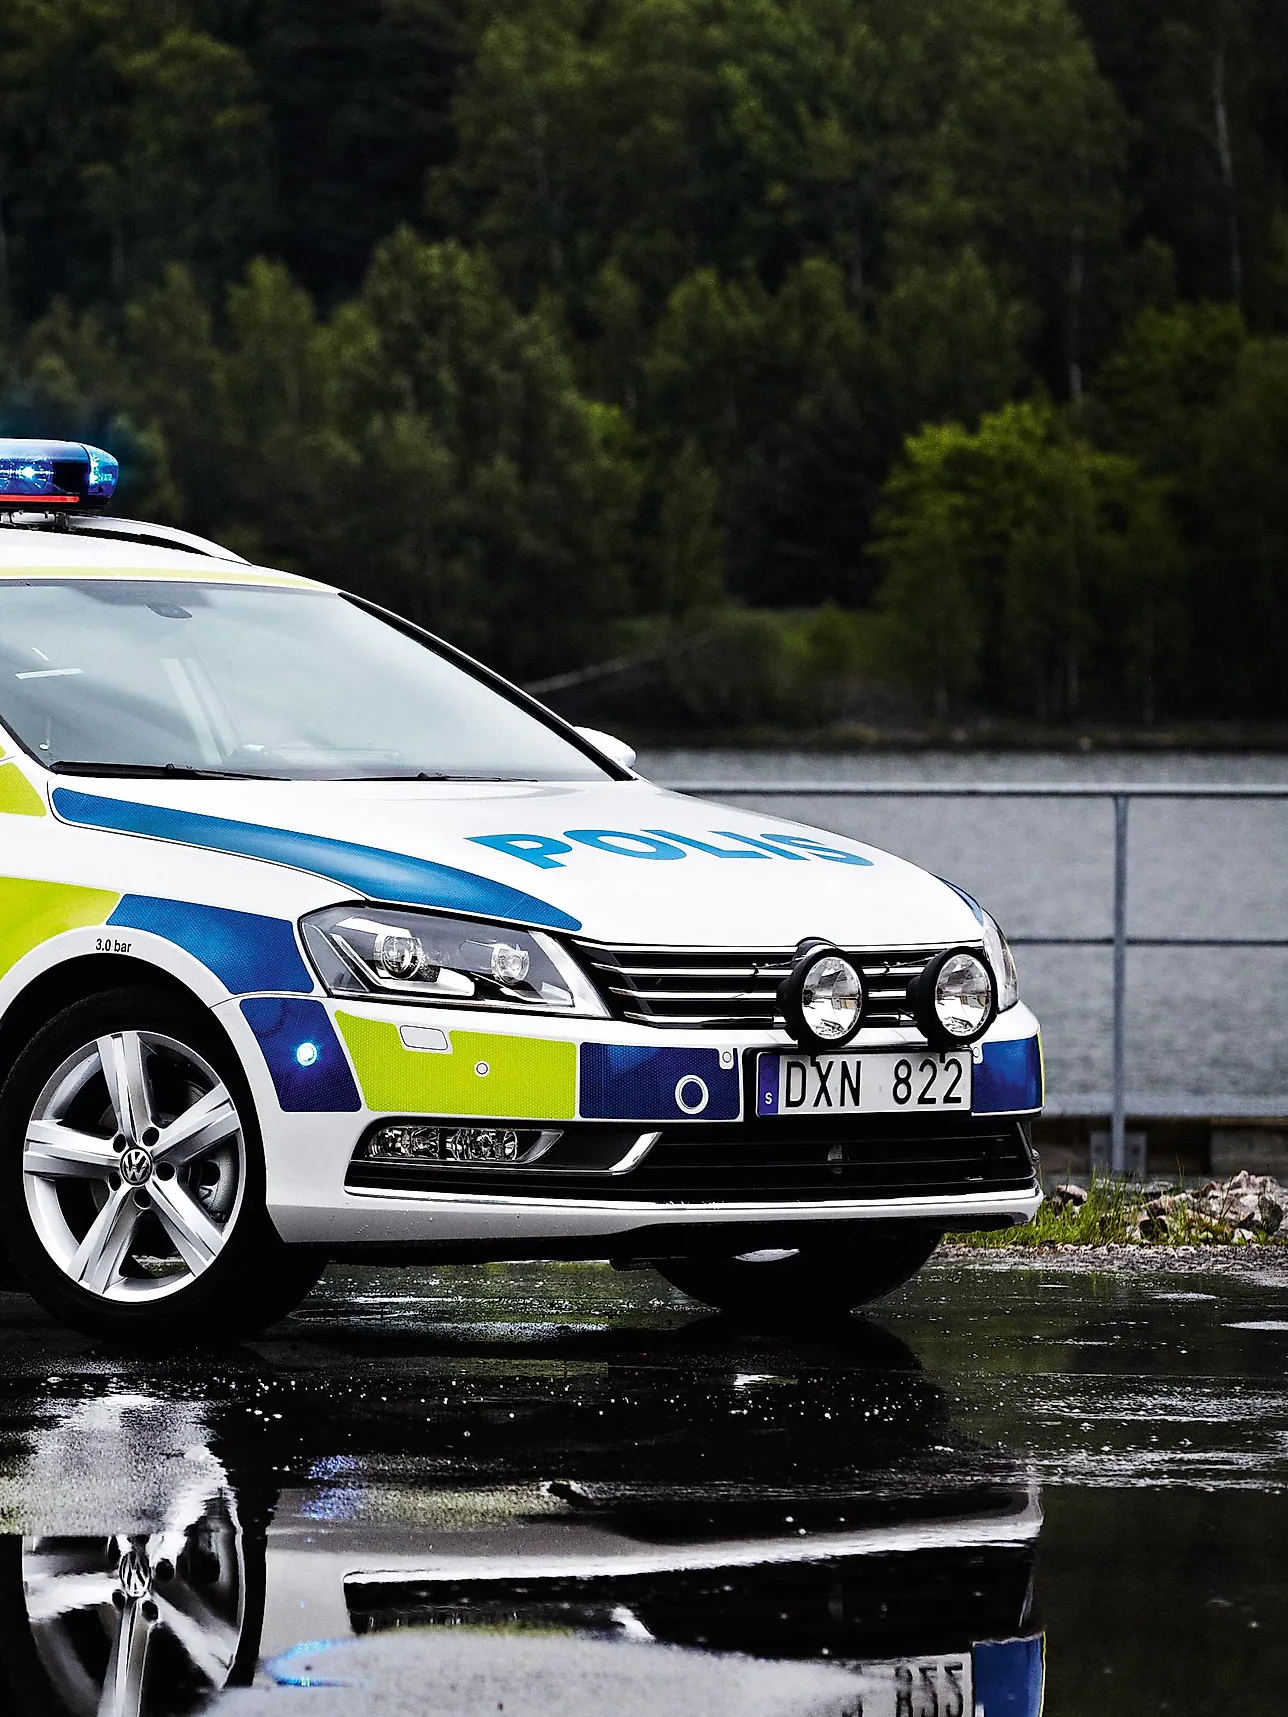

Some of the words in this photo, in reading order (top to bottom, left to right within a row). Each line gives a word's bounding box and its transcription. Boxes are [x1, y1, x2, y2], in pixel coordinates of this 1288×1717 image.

[463, 829, 874, 869] POLIS
[95, 938, 111, 951] 3.0
[114, 939, 132, 952] bar
[765, 1092, 773, 1105] S
[785, 1060, 862, 1108] DXN
[892, 1058, 963, 1105] 822
[122, 1148, 151, 1184] VW
